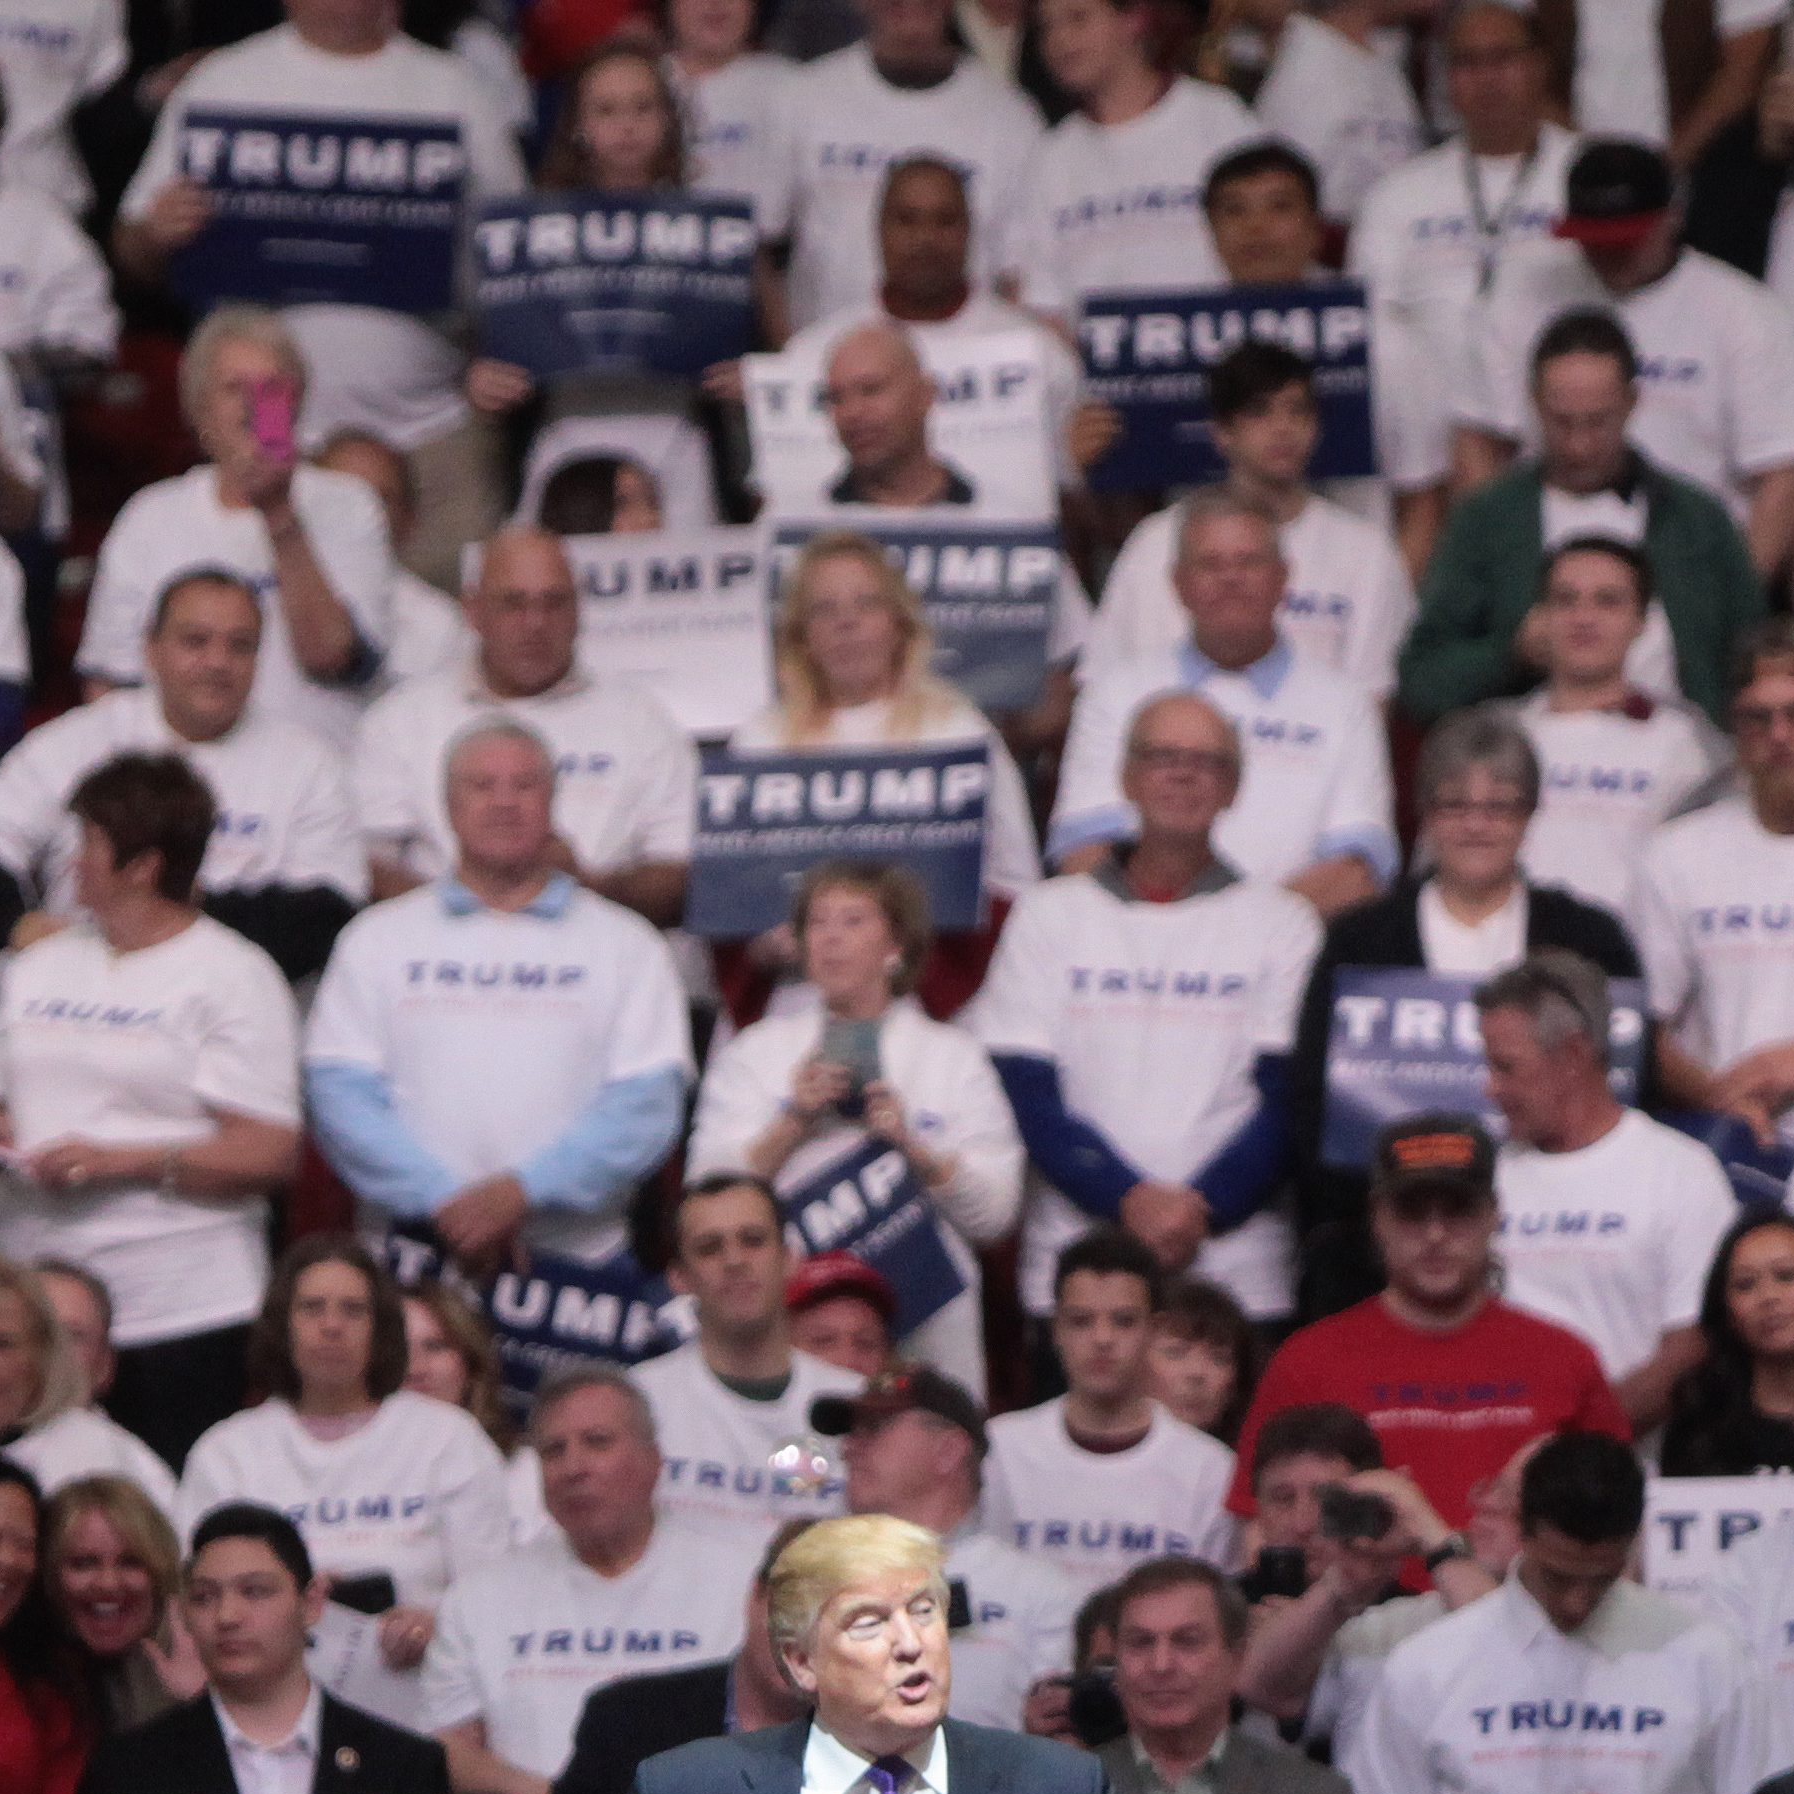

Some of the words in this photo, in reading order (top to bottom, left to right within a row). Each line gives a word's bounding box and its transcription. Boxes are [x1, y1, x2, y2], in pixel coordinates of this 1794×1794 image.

[180, 126, 463, 187] TRUMP
[476, 213, 753, 267] TRUMP
[1086, 303, 1367, 370] TRUMP
[584, 554, 757, 600] UMP
[702, 763, 984, 823] TRUMP
[406, 960, 586, 988] TRUMP
[1068, 967, 1252, 997] TRUMP
[1334, 999, 1636, 1054] TRP
[1498, 1211, 1627, 1238] UMP
[288, 1498, 427, 1527] RUMP
[1014, 1521, 1206, 1556] TRUMP
[511, 1630, 701, 1658] TRUMP
[1471, 1702, 1666, 1734] TRUMP
